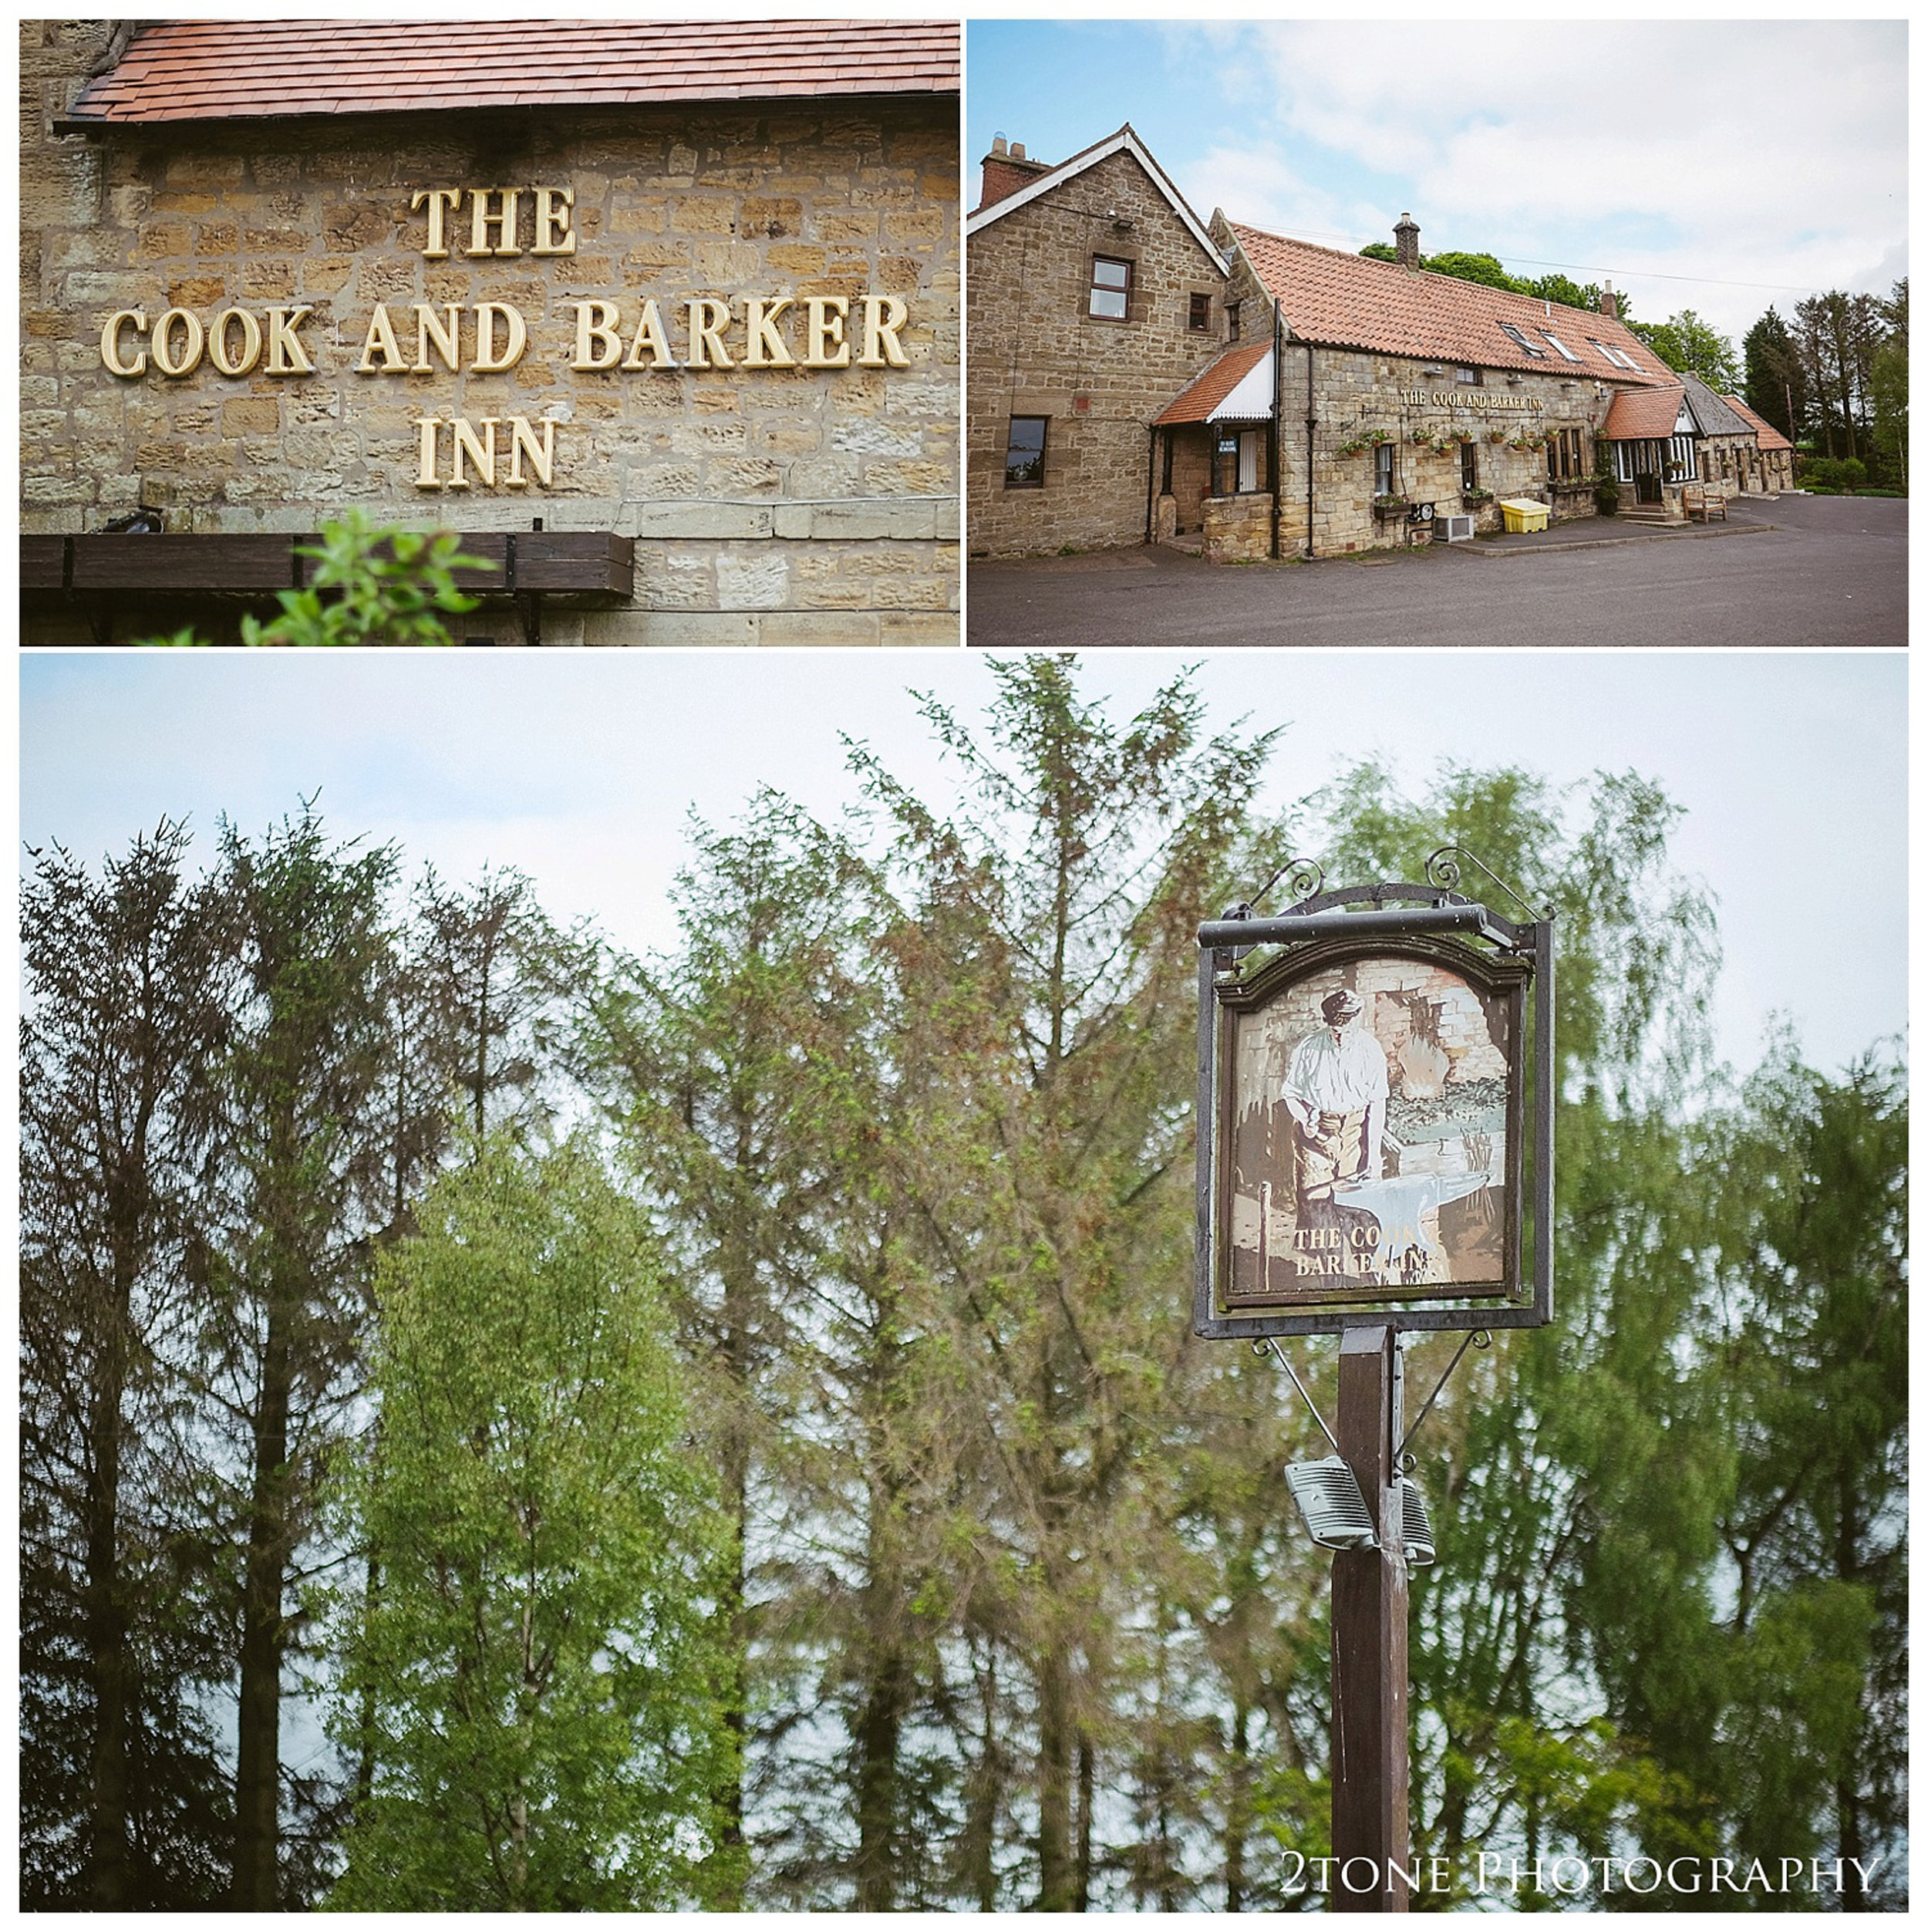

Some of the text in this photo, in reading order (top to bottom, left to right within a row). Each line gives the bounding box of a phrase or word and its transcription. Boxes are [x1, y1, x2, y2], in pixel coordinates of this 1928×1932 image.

[411, 187, 577, 258] THE
[100, 295, 911, 376] COOK AND BARKER
[1400, 389, 1426, 405] THE
[1432, 392, 1464, 407] COOK
[1466, 393, 1487, 409] AND
[1491, 396, 1526, 410] BARKER
[413, 416, 560, 489] INN
[1295, 1228, 1340, 1251] THE
